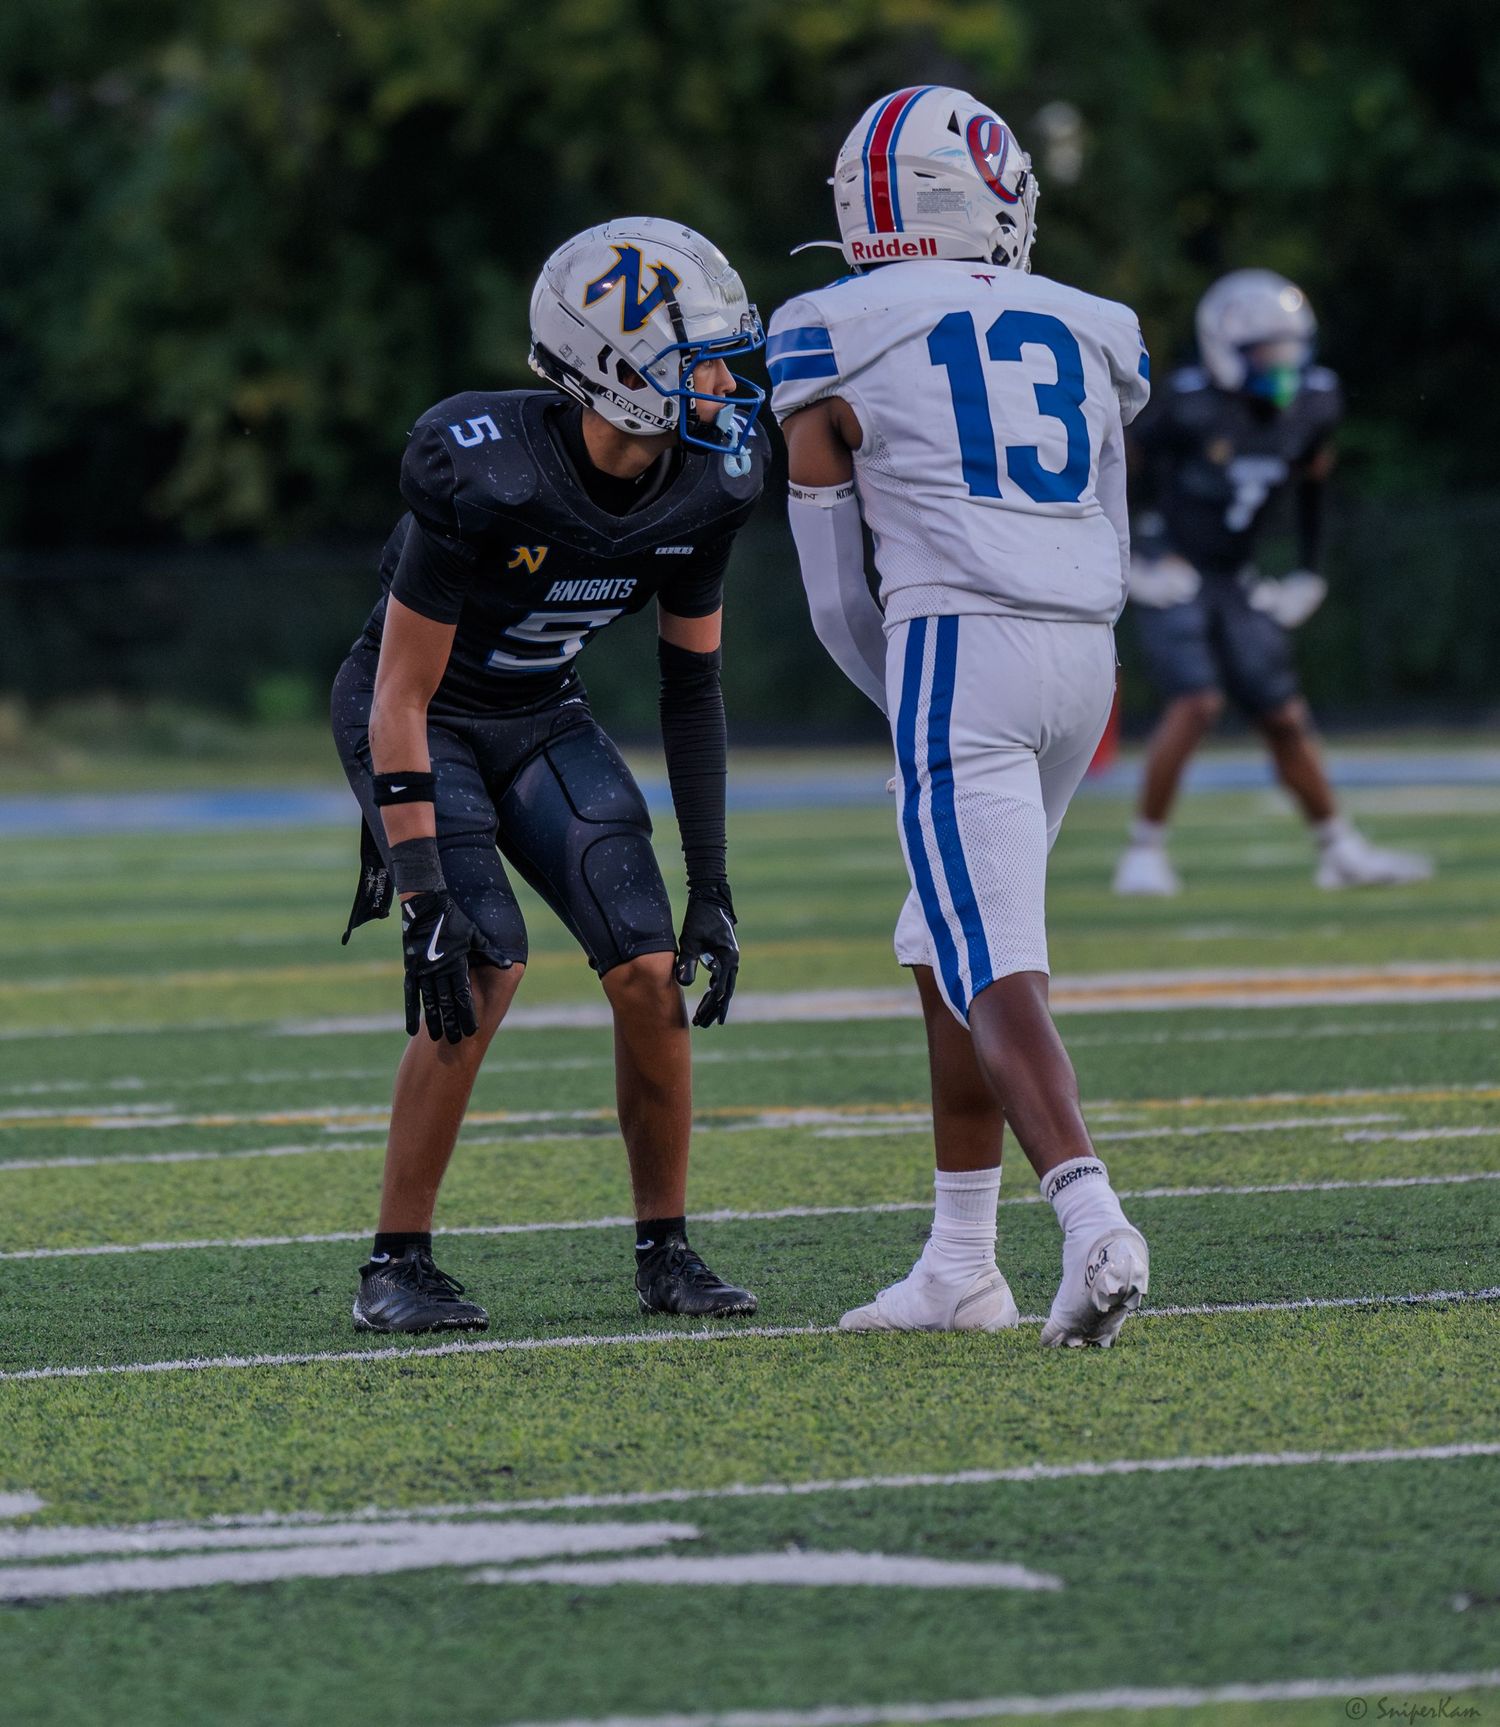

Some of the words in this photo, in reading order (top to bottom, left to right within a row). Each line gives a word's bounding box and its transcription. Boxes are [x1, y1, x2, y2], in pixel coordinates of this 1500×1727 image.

[851, 238, 938, 261] Riddell
[926, 309, 1091, 503] 13
[448, 414, 503, 449] 5
[544, 578, 638, 601] KNIGHTS
[486, 606, 627, 673] 5
